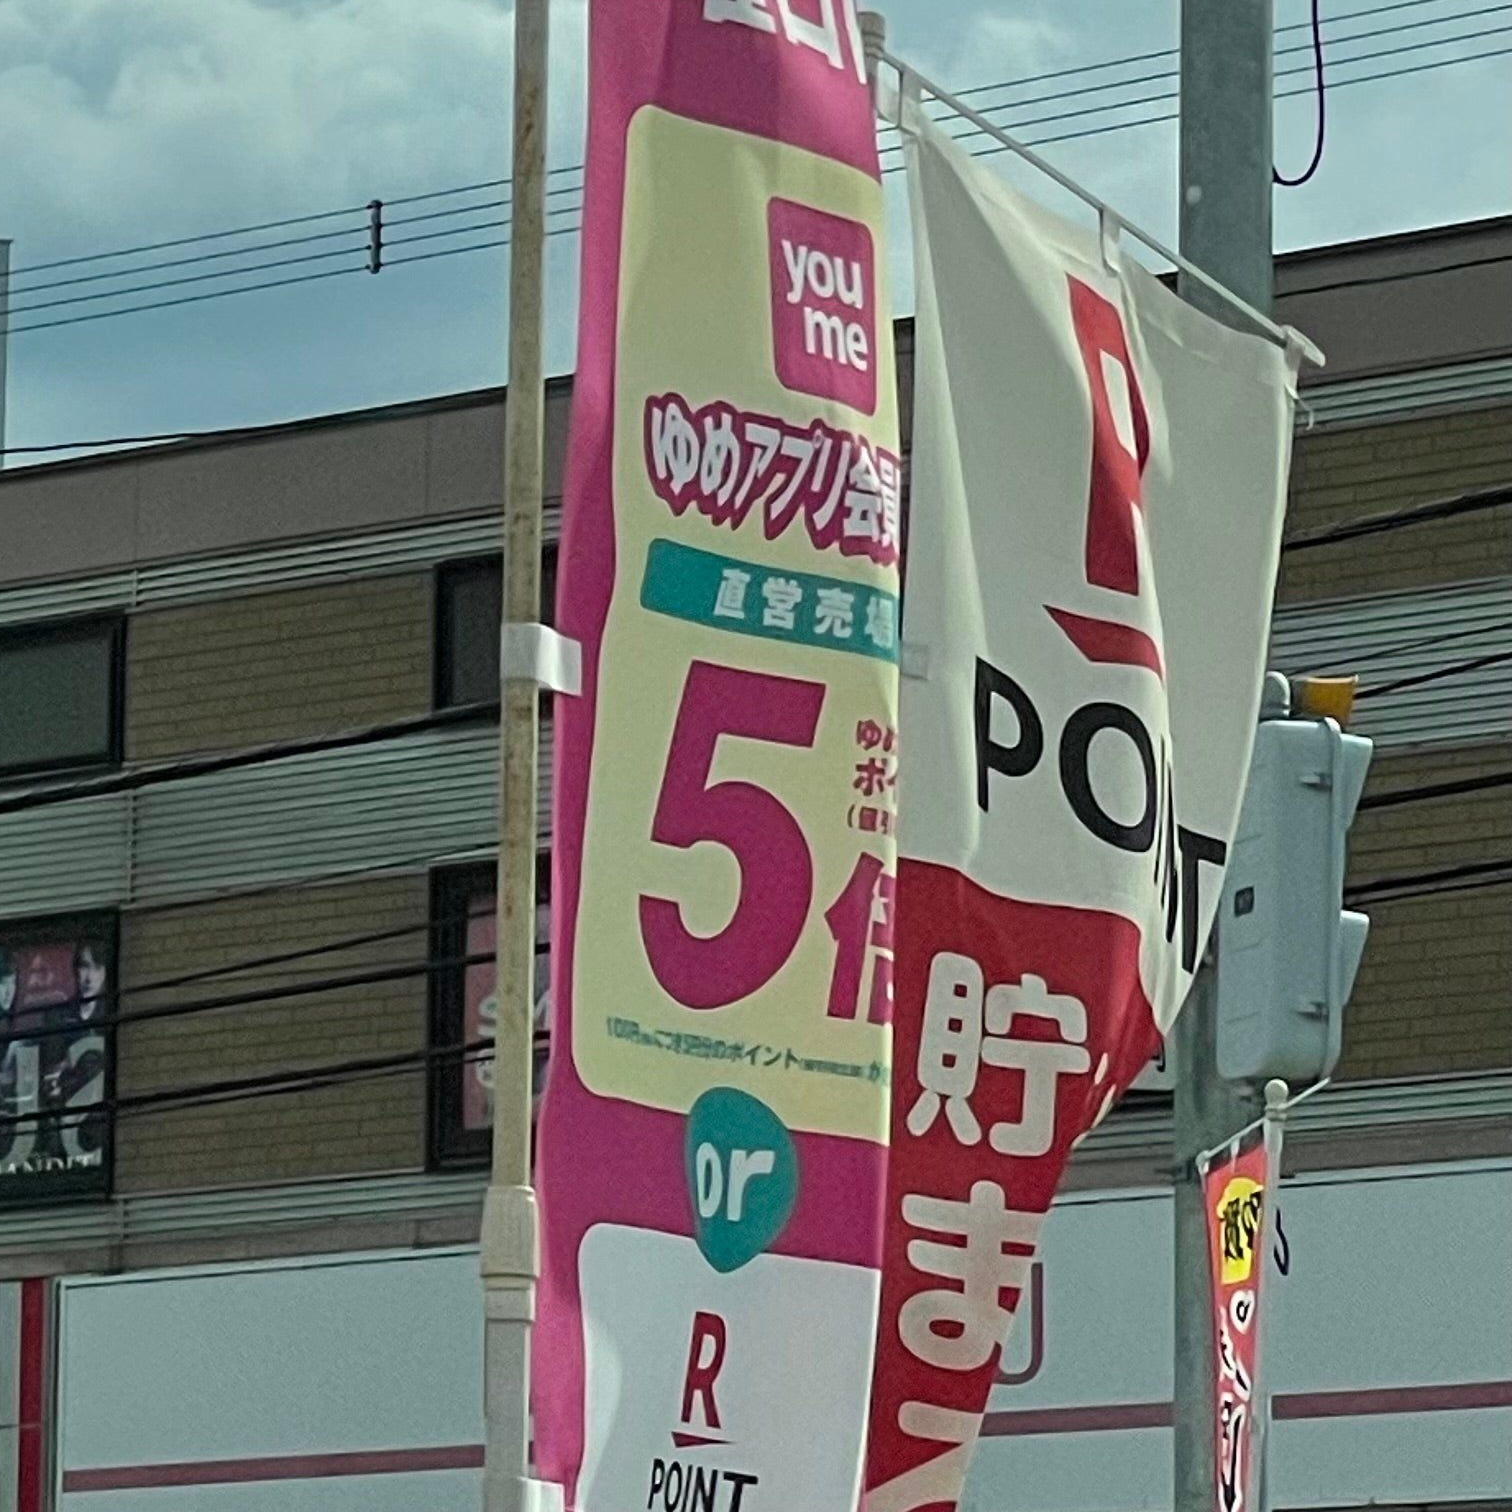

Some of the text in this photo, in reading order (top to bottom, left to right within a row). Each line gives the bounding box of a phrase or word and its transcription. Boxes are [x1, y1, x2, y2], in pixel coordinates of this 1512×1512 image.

[781, 239, 863, 308] you
[804, 306, 869, 371] me
[696, 1141, 775, 1221] or
[681, 1310, 727, 1429] R
[647, 1458, 758, 1512] POINT
